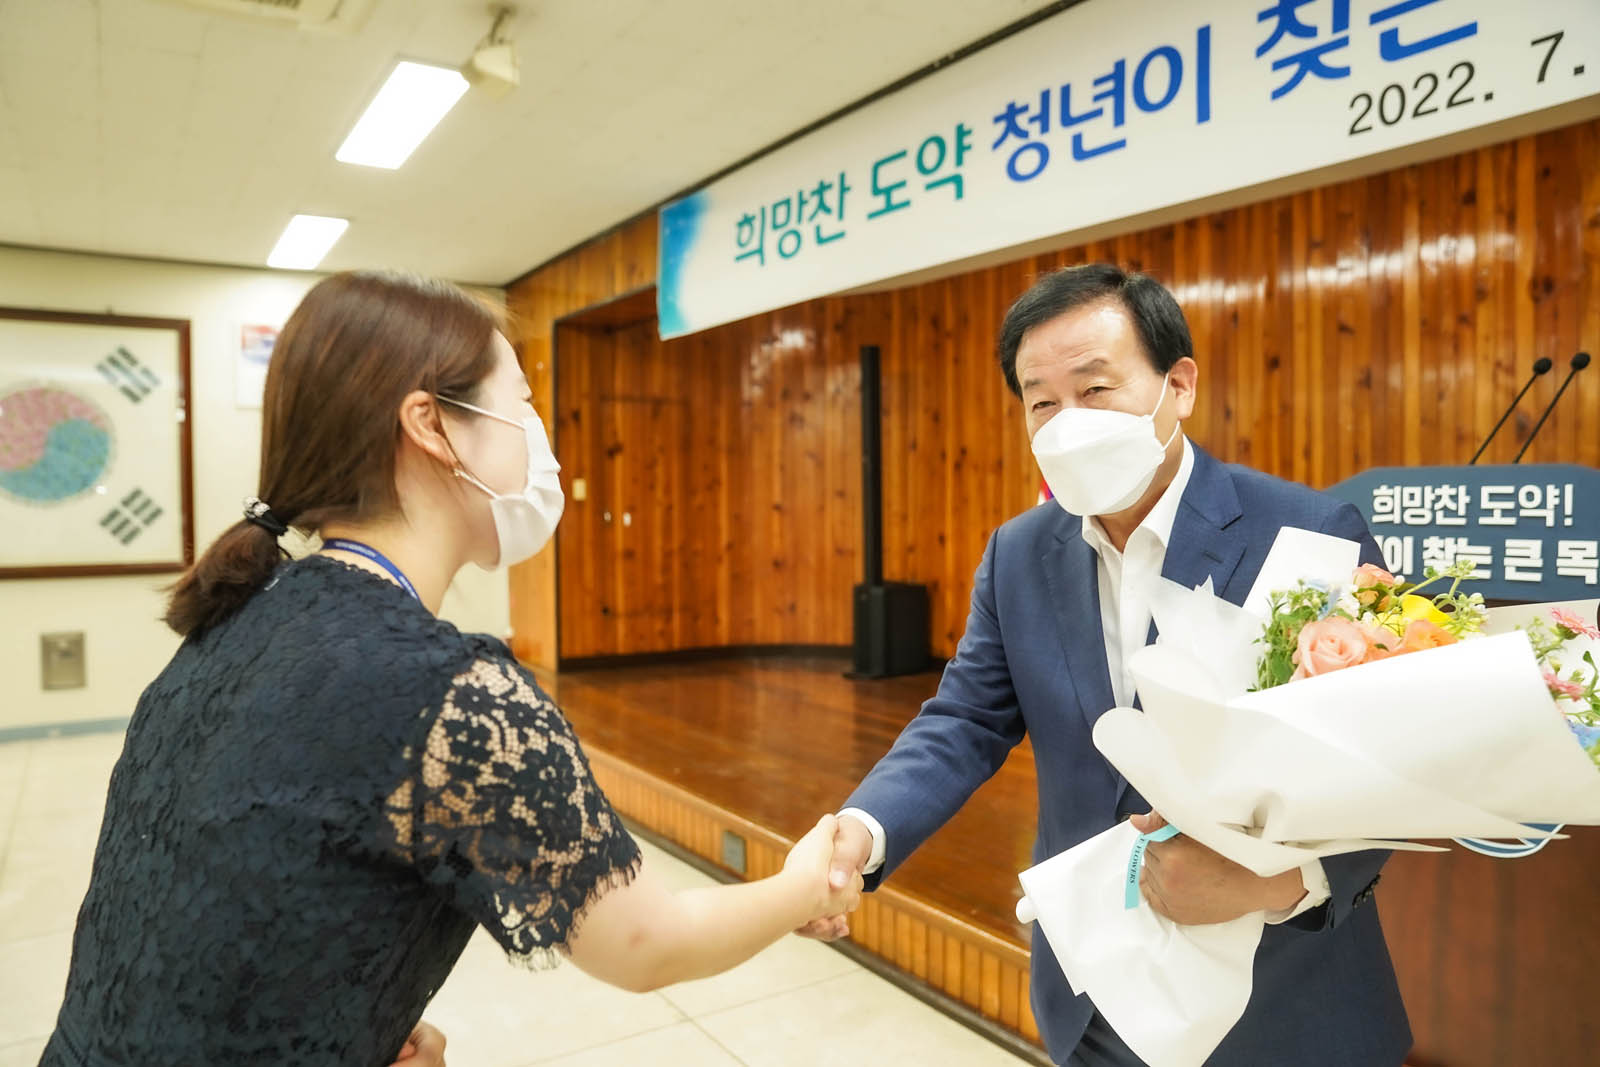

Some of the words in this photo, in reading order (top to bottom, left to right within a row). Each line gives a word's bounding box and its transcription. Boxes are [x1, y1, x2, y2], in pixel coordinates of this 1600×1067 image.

[1348, 61, 1494, 136] 2022.
[1531, 31, 1585, 83] 7.
[734, 172, 851, 266] 희망찬
[867, 122, 973, 219] 도약
[991, 24, 1211, 183] 청년이
[1371, 484, 1470, 526] 희망찬
[1478, 483, 1574, 527] 도약!
[1374, 534, 1414, 576] 이
[1504, 538, 1543, 582] 큰
[1556, 540, 1599, 585] 목
